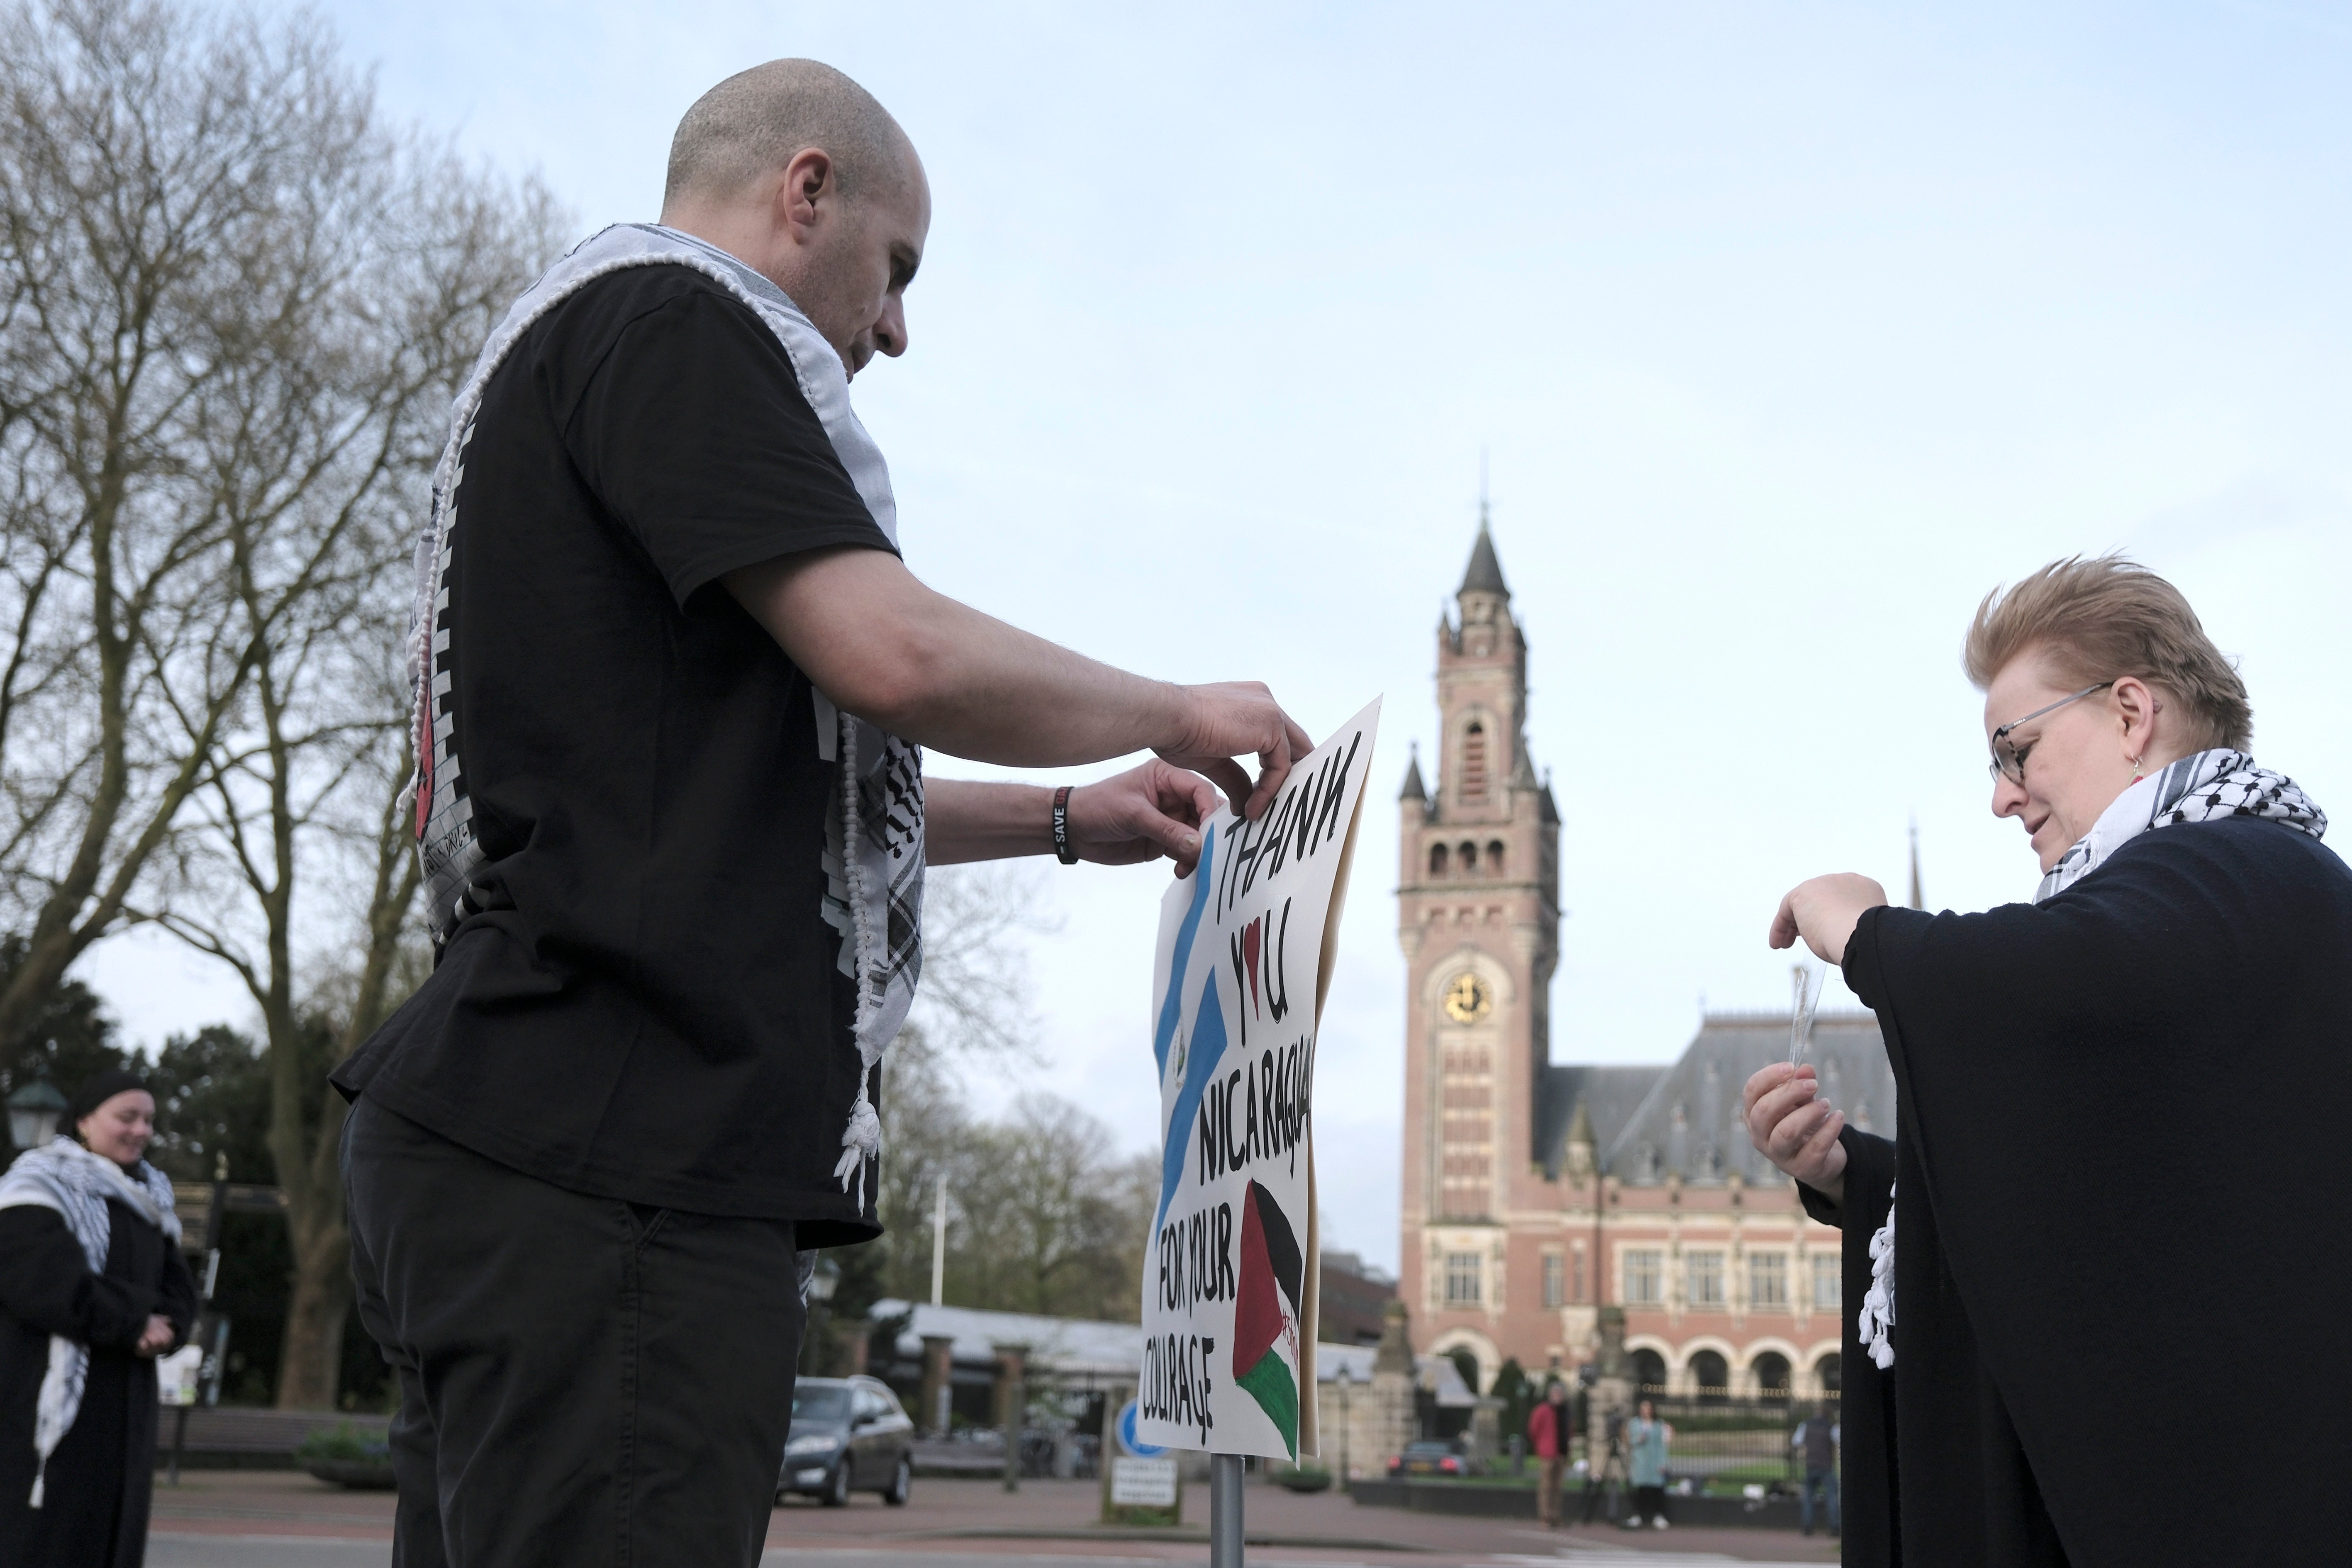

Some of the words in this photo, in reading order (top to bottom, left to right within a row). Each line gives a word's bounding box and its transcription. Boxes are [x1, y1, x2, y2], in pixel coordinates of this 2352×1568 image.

[1055, 808, 1065, 842] SAVE
[1217, 731, 1361, 925] THANK
[1200, 1034, 1311, 1186] NICARAGUA
[1160, 1219, 1185, 1312] FOR
[1189, 1202, 1235, 1320] YOUR
[1143, 1333, 1214, 1447] COURAGE
